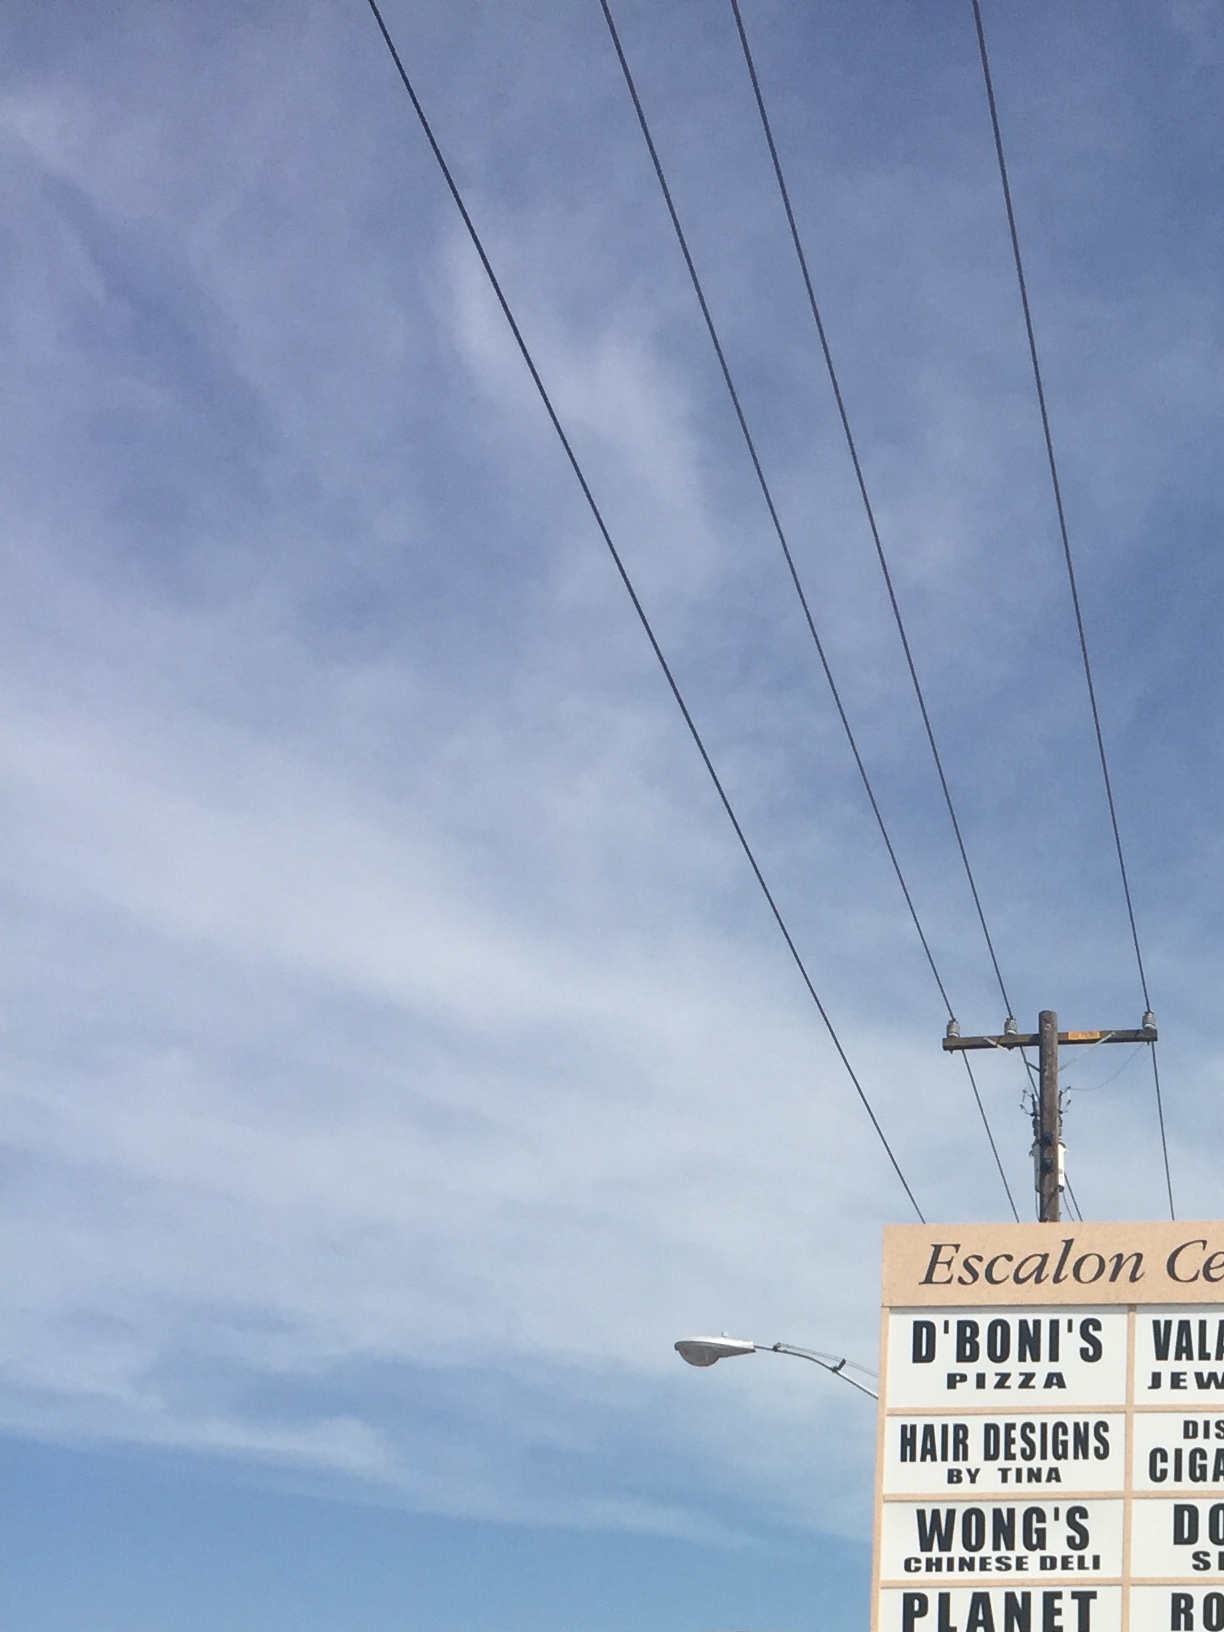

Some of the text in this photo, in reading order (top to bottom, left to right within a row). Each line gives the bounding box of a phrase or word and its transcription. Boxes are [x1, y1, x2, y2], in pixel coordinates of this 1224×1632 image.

[919, 1238, 1143, 1285] Escalon
[912, 1318, 1102, 1364] D'BONI'S
[947, 1372, 1067, 1389] PIZZA
[900, 1421, 1110, 1462] HAIR DESIGNS
[947, 1467, 1062, 1485] BY TINA
[916, 1506, 1089, 1552] WONG'S
[903, 1554, 1101, 1573] CHINESE DELI
